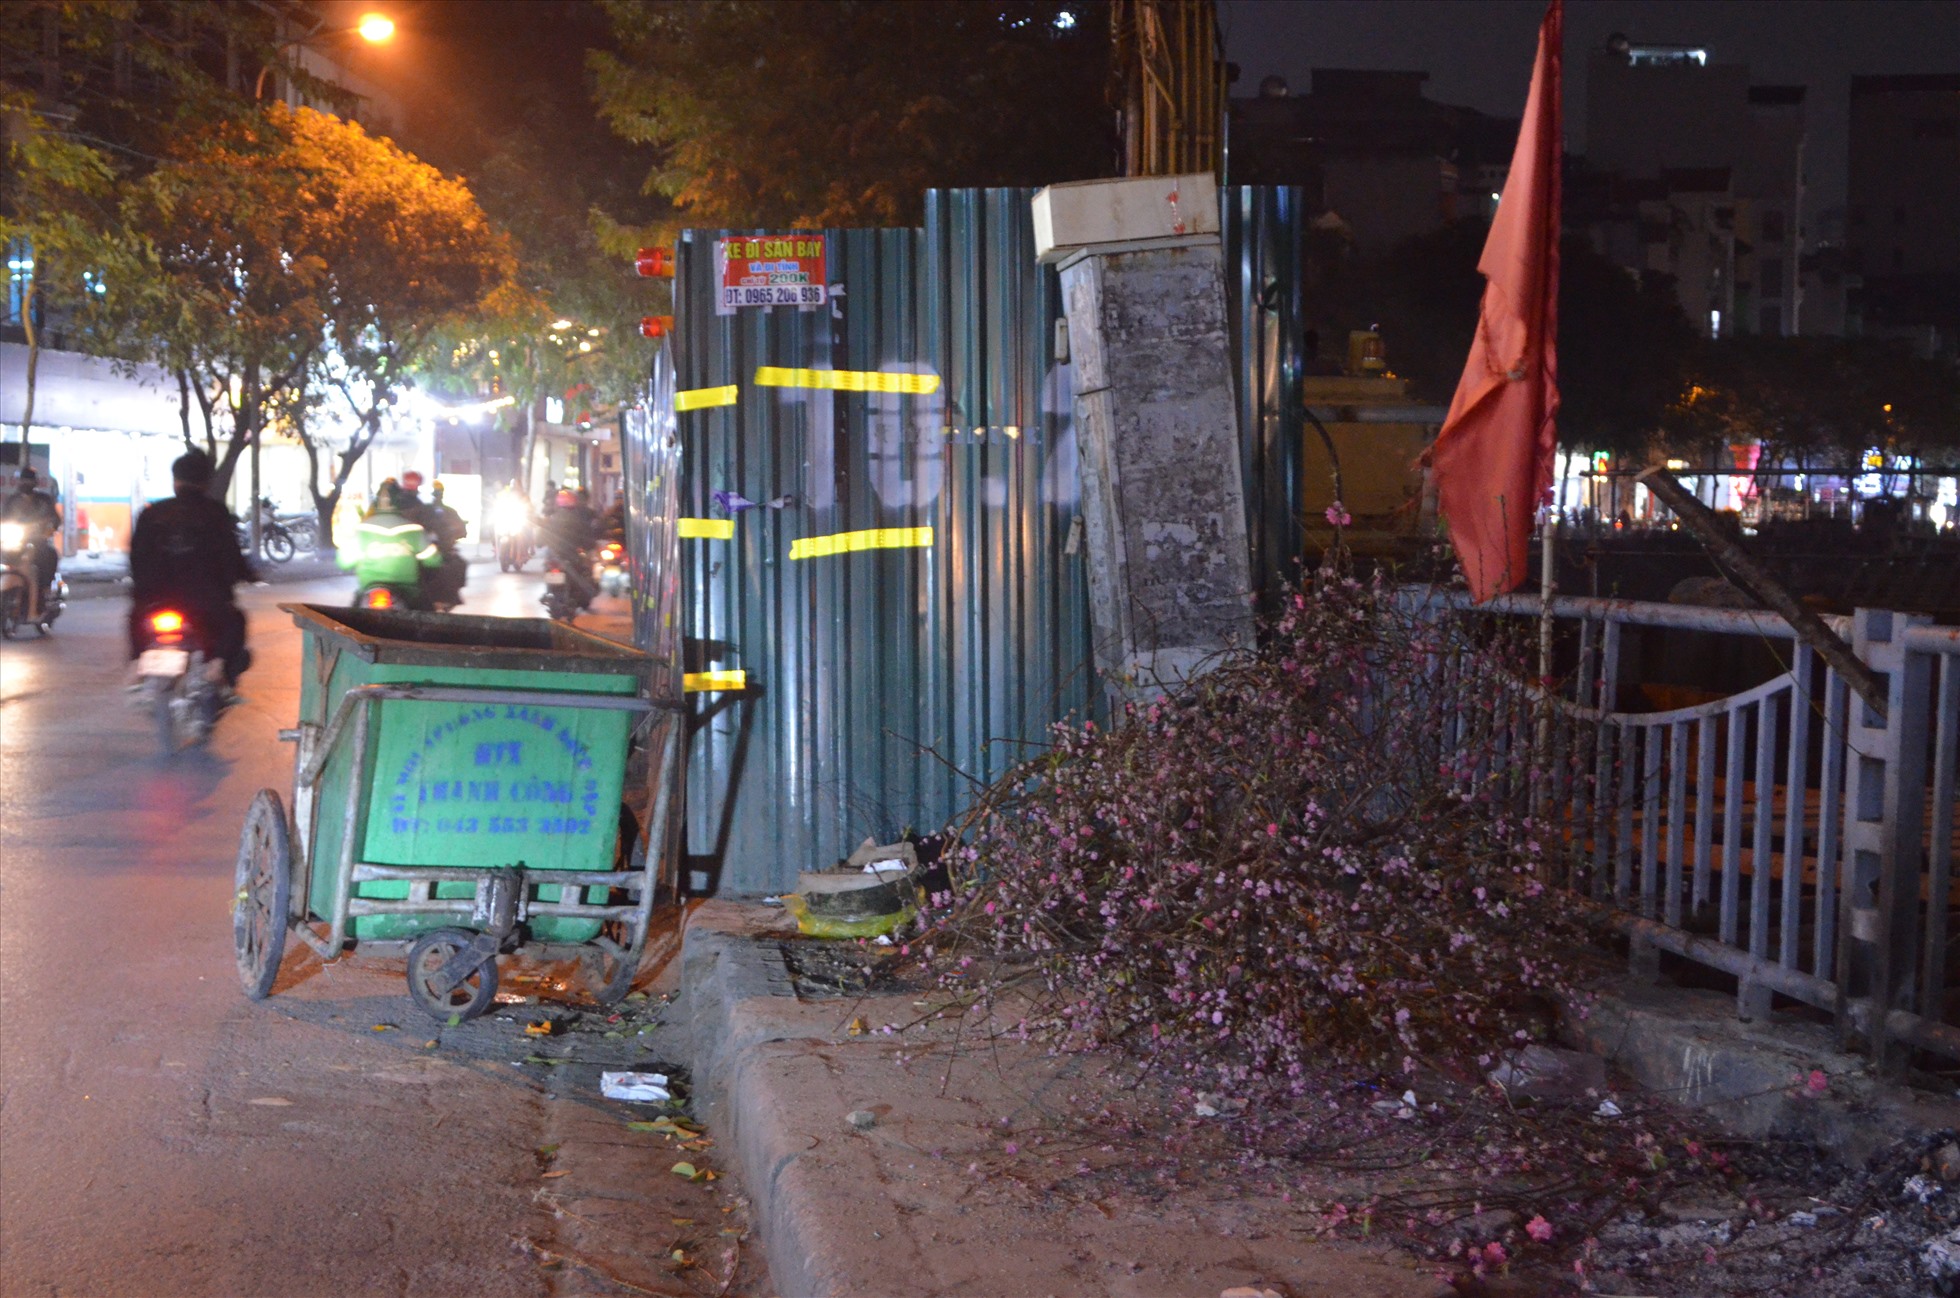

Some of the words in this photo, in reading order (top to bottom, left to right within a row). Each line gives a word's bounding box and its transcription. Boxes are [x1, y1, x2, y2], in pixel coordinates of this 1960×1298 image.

[726, 242, 741, 258] XE
[798, 241, 821, 258] BAY
[745, 288, 773, 304] 0965
